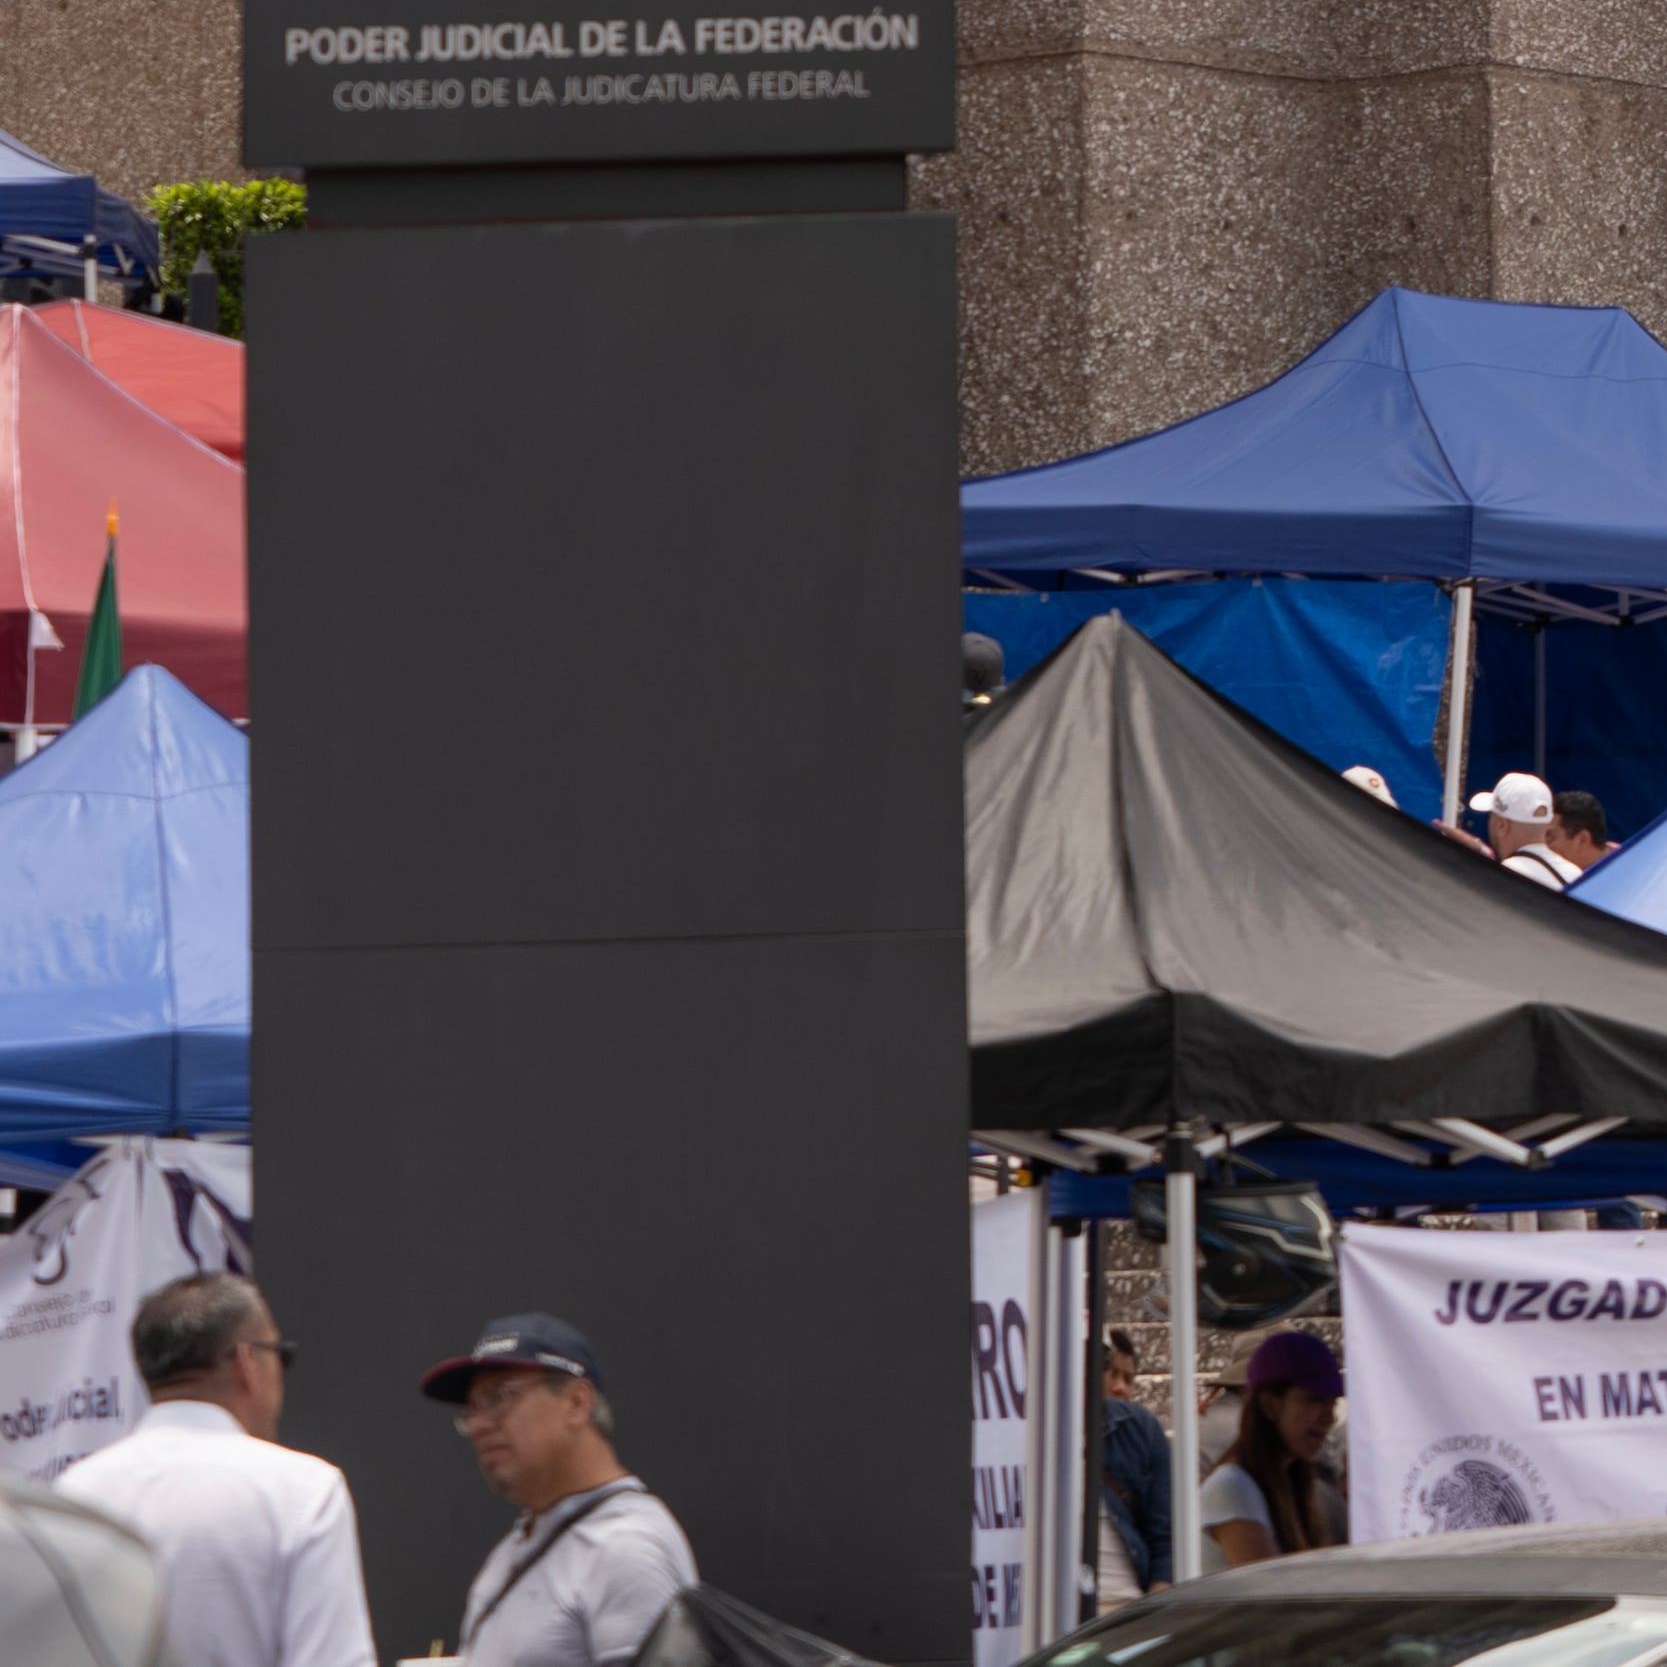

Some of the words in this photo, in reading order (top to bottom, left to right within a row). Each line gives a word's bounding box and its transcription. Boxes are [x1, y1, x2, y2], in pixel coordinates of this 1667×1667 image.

[285, 25, 411, 65] PODER
[415, 21, 574, 62] JUDICIAL
[578, 19, 629, 57] DE
[635, 18, 687, 56] LA
[694, 5, 919, 54] FEDERACIÓN
[332, 77, 466, 111] CONSEJO
[470, 77, 512, 108] DE
[516, 76, 556, 107] LA
[560, 72, 742, 105] JUDICATURA
[747, 69, 873, 101] FEDERAL
[1533, 1374, 1587, 1422] EN
